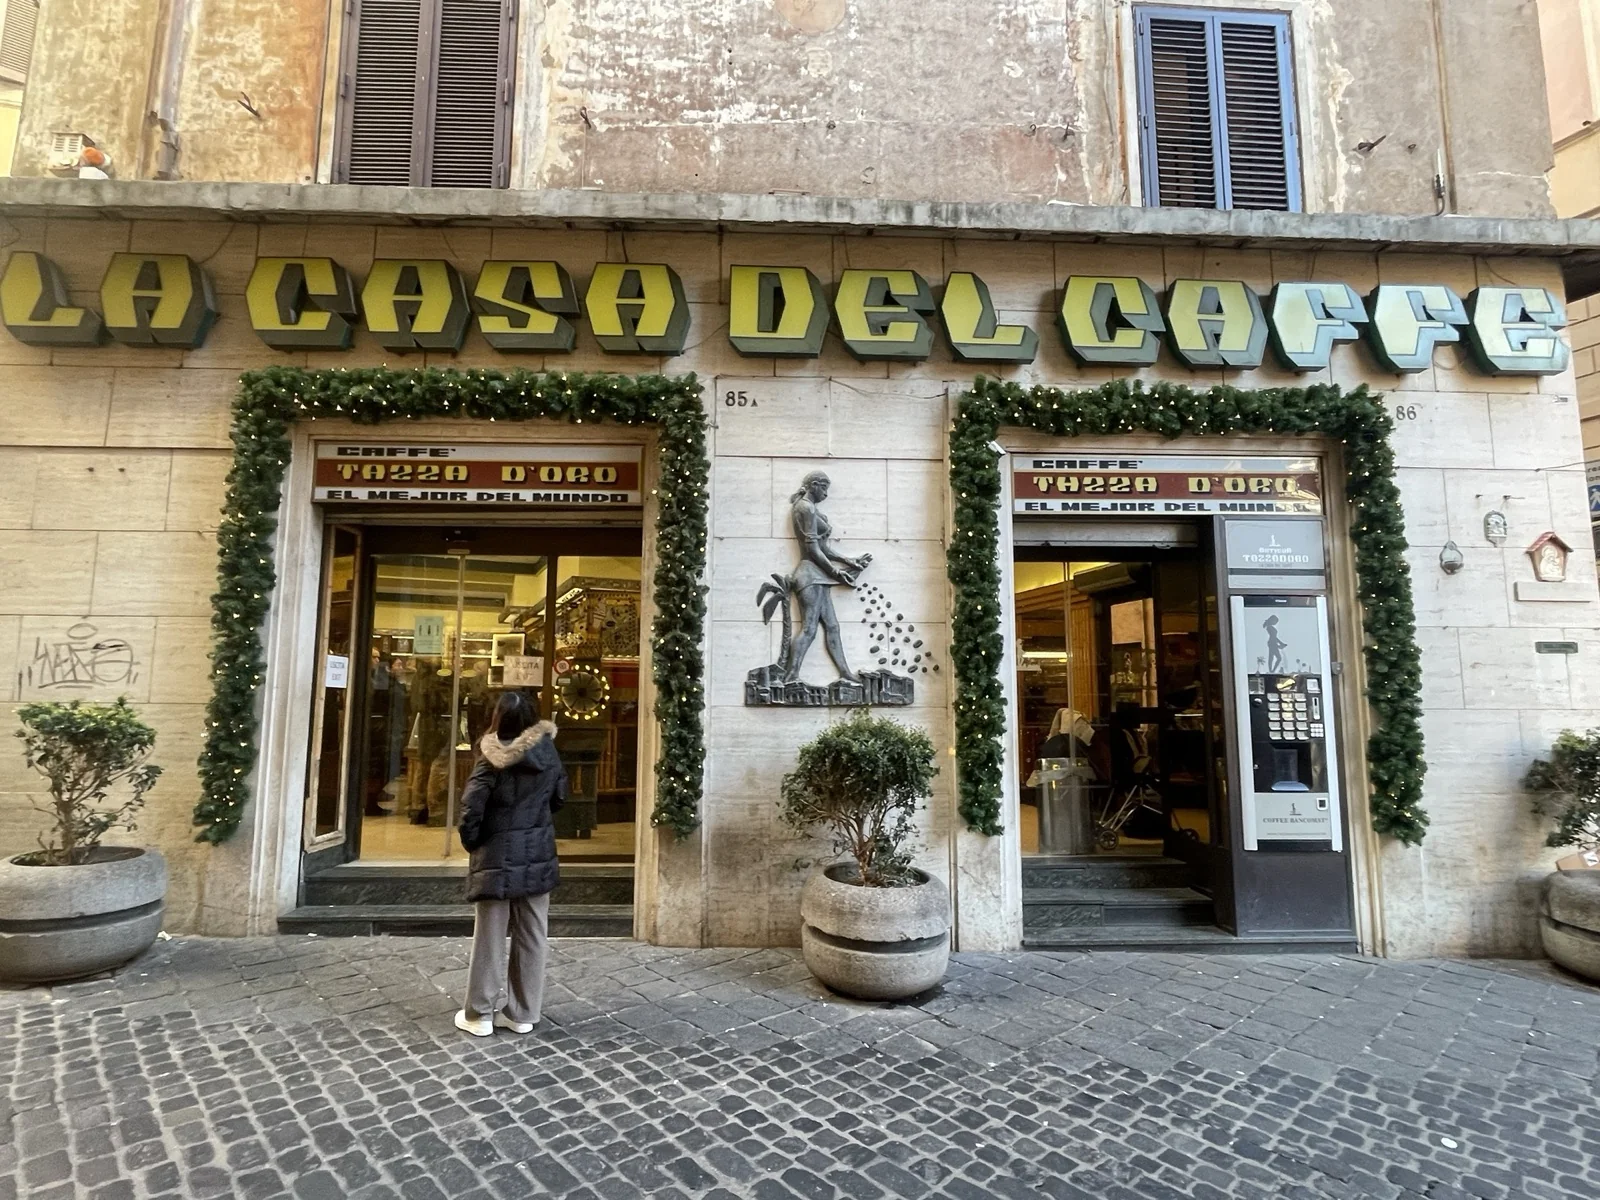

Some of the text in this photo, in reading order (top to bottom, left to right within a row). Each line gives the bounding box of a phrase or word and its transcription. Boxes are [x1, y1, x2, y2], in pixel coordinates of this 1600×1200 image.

[1, 251, 1563, 368] LA CASA DEL CAFFE
[1396, 405, 1417, 420] 86
[337, 464, 617, 483] TAZZA D'ORO
[1033, 476, 1158, 493] TAZZA
[327, 490, 629, 502] EL MEJOR DEL MUNDO
[1025, 502, 1054, 511] EL
[1061, 502, 1155, 511] MEJOR
[1164, 503, 1211, 511] DEL
